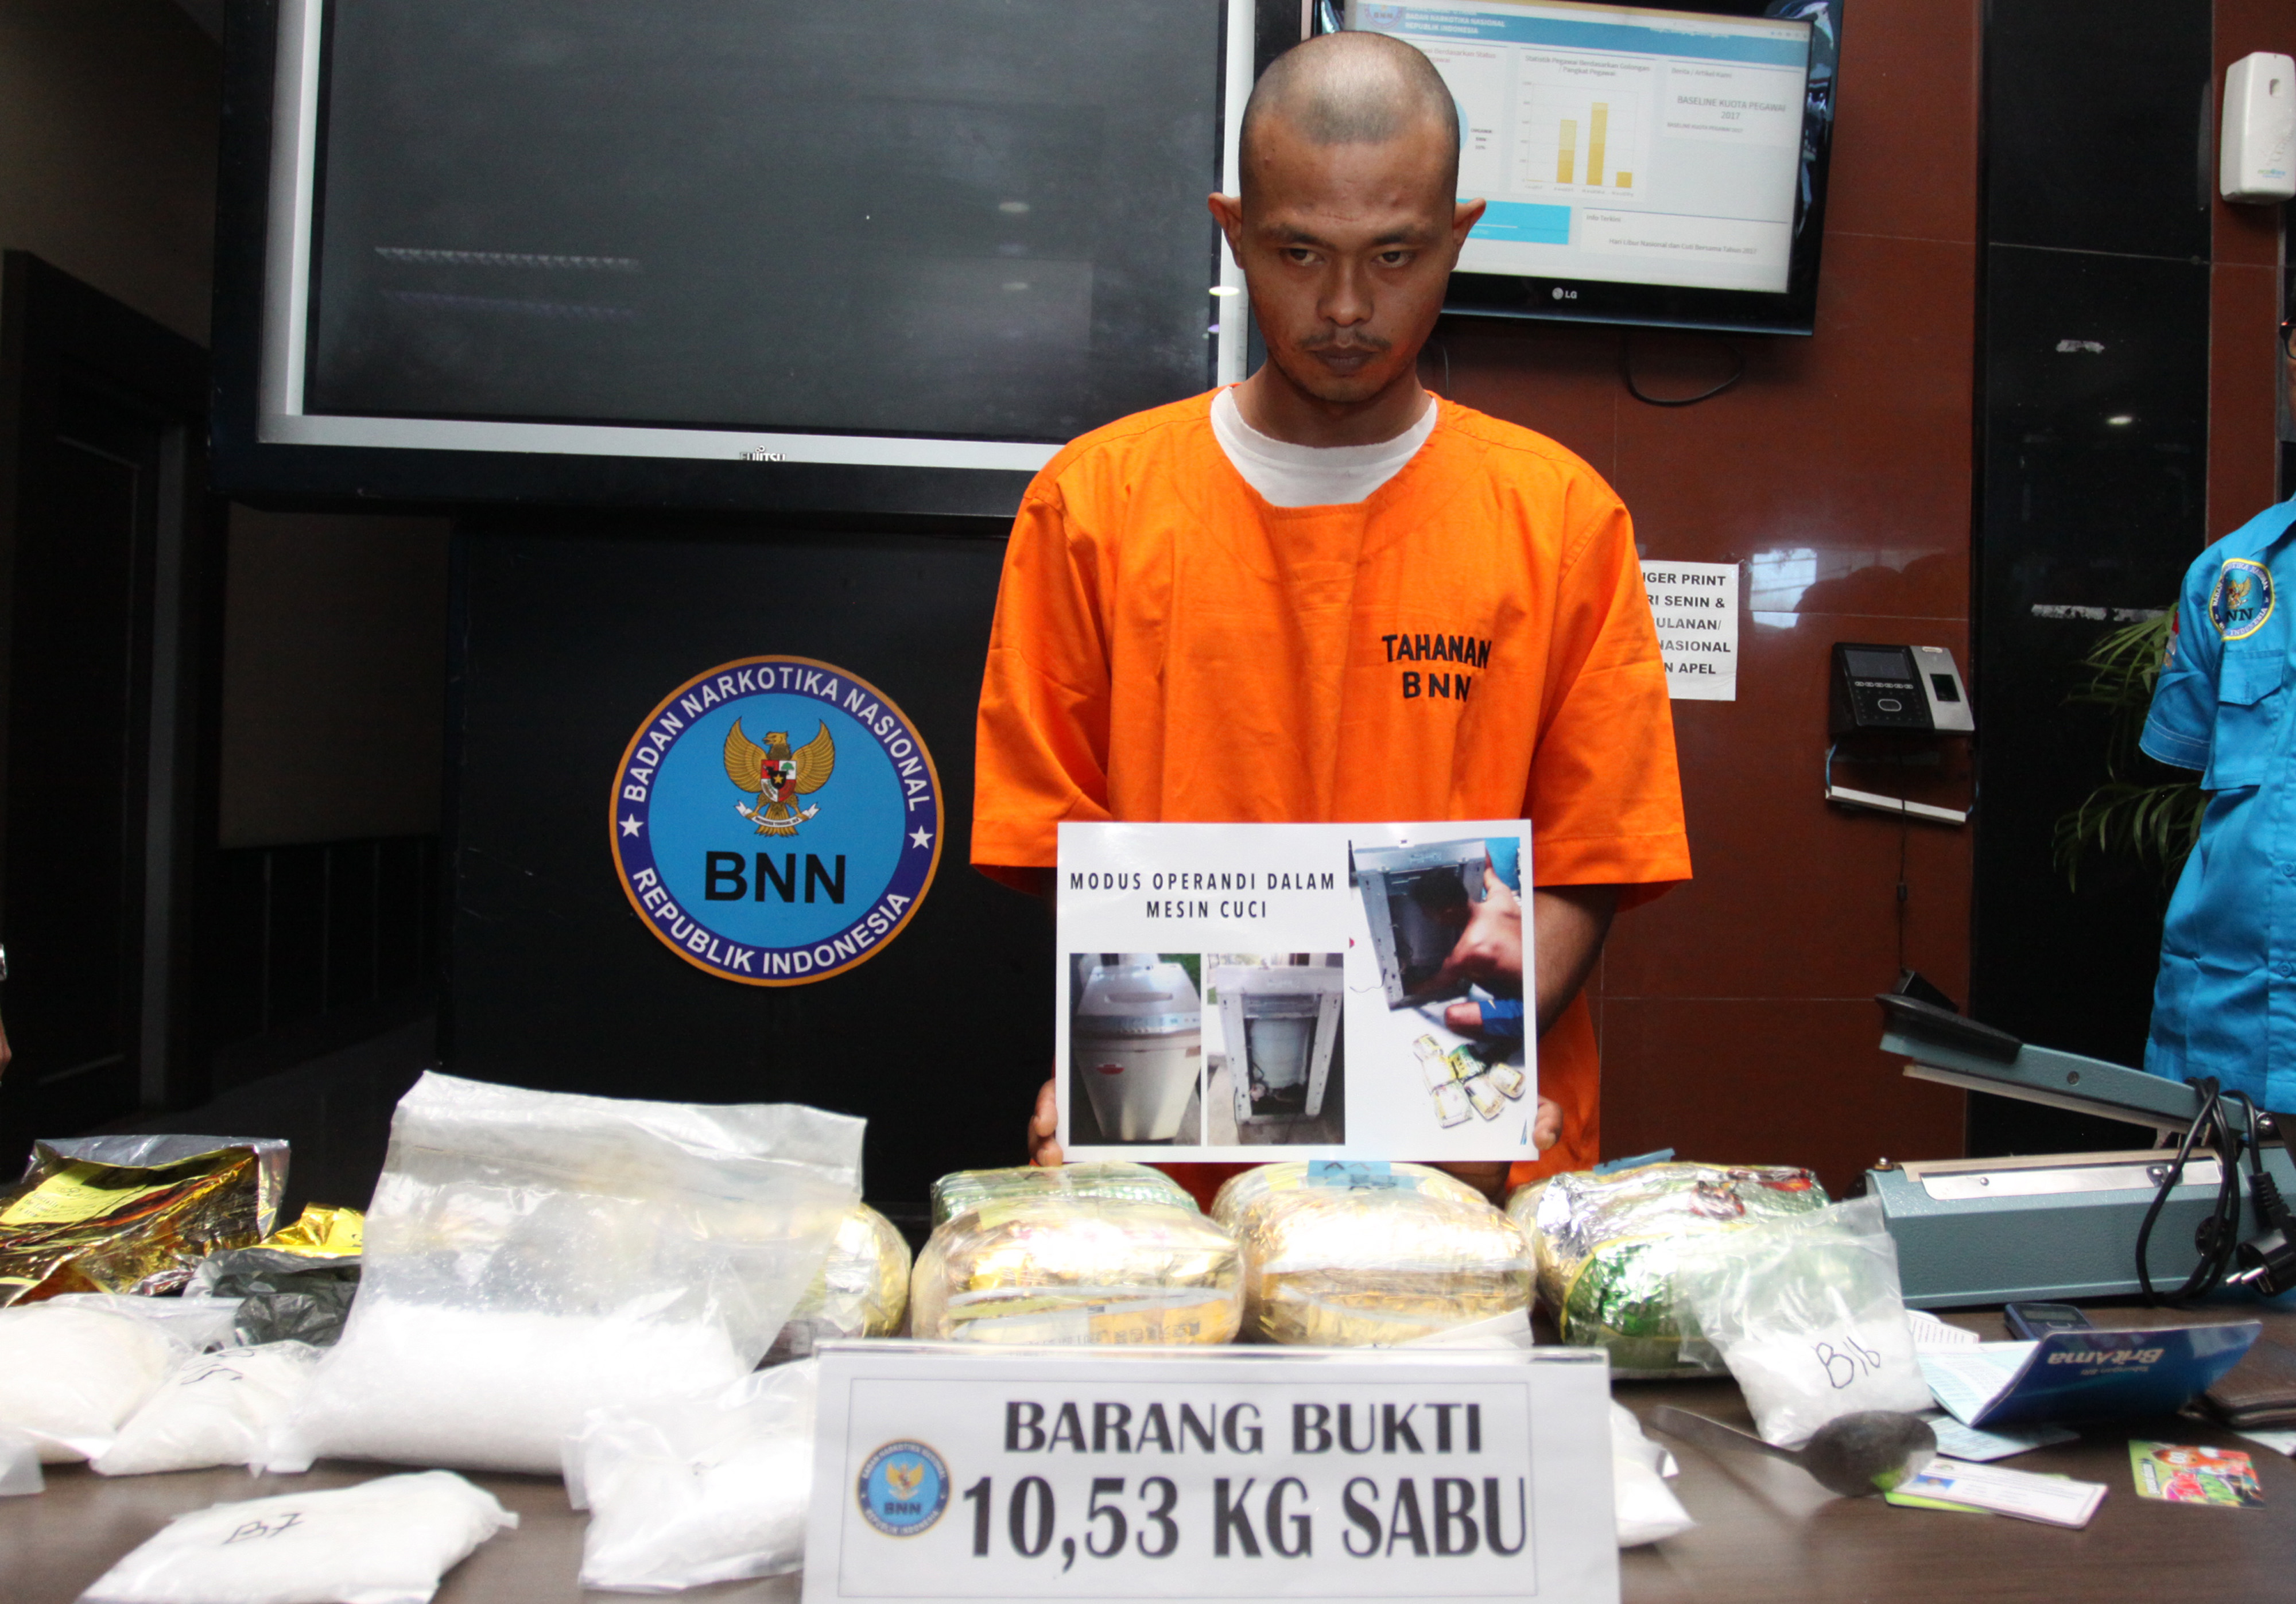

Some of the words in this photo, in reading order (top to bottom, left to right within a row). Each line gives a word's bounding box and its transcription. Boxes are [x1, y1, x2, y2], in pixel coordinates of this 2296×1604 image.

[1430, 14, 1469, 24] NARKOTIKA
[1470, 18, 1505, 27] NASIONAL
[1405, 22, 1438, 30] REPUBLIK
[1440, 25, 1479, 34] INDONESIA
[1552, 58, 1578, 67] Pegawai
[1579, 60, 1619, 69] Berdasarkan
[1620, 63, 1650, 72] Golongan
[1563, 67, 1588, 75] Pangkat
[1589, 68, 1616, 77] Pegawai
[1677, 96, 1717, 107] BASELINE
[1719, 98, 1747, 109] KUOTA
[1748, 102, 1786, 112] PEGAWAI
[1721, 111, 1741, 120] 2017
[1600, 215, 1621, 223] Terkini
[1623, 239, 1639, 247] Libur
[1640, 240, 1667, 248] Nasional
[1695, 244, 1721, 253] Bersama
[1723, 246, 1742, 254] Tahun
[1565, 290, 1577, 299] LG
[1643, 572, 1677, 584] GER
[1681, 574, 1726, 586] PRINT
[1647, 595, 1659, 606] RI
[1665, 595, 1710, 608] SENIN
[1715, 597, 1725, 608] &
[1655, 617, 1722, 631] ULANAN/
[1382, 634, 1492, 669] TAHANAN
[1678, 663, 1717, 674] APEL
[1402, 671, 1472, 702] BNN
[623, 712, 684, 803] BADAN
[680, 666, 839, 719] NARKOTIKA
[843, 688, 931, 813] NASIONAL
[704, 850, 846, 904] BNN
[1070, 872, 1142, 890] MODUS
[1152, 872, 1256, 890] OPERANDI
[1267, 872, 1335, 891] DALAM
[1146, 900, 1208, 918] MESIN
[1220, 900, 1266, 918] CUCI
[633, 867, 756, 973] REPUBLIK
[762, 891, 911, 975] INDONESIA
[2046, 1348, 2166, 1365] BritAma
[1004, 1401, 1263, 1455] BARANG
[1292, 1403, 1481, 1454] BUKTI
[883, 1502, 922, 1514] BNN
[962, 1475, 1180, 1574] 10,53
[1212, 1476, 1313, 1560] KG
[1341, 1475, 1527, 1560] SABU
